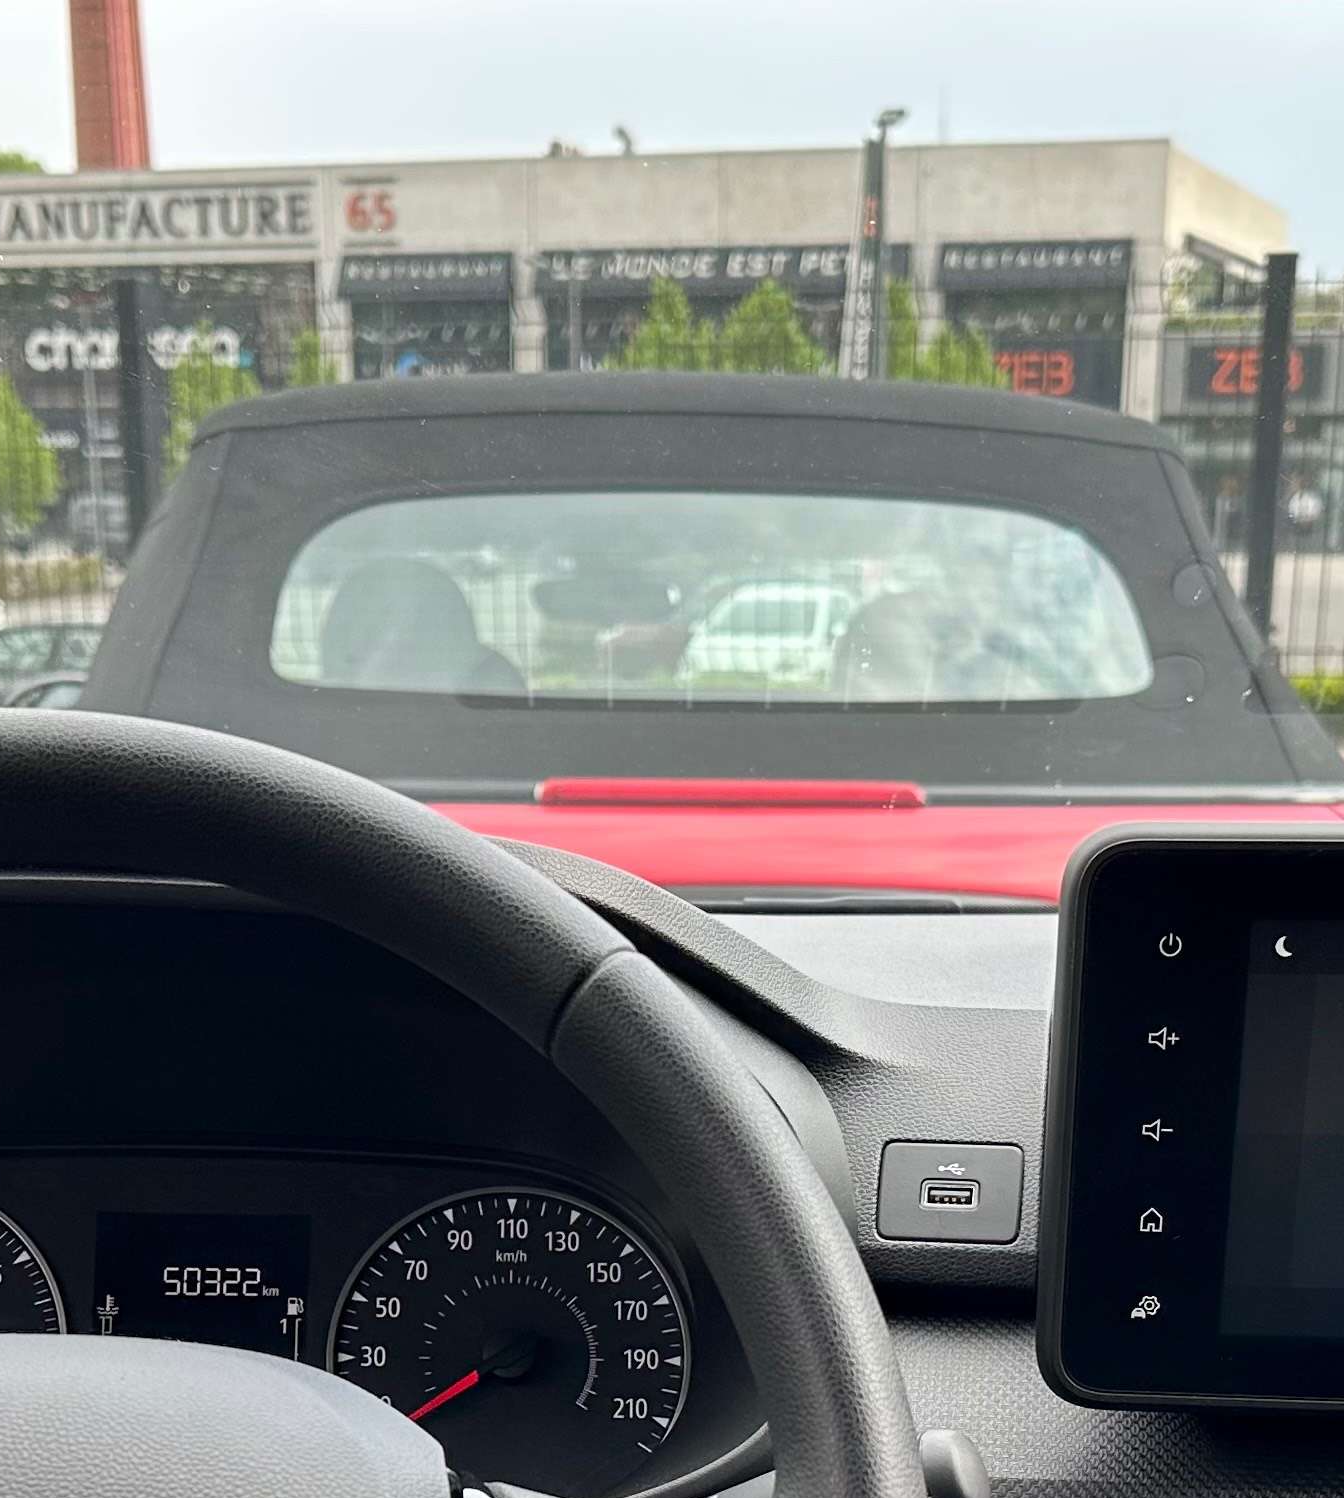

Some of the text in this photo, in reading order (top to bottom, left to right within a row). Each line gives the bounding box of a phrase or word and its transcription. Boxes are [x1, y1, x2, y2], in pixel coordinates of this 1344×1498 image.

[344, 190, 398, 232] 65
[447, 1229, 473, 1251] 90
[497, 1219, 529, 1239] 110
[544, 1231, 580, 1252] 130
[495, 1249, 527, 1264] km/h
[404, 1259, 428, 1281] 70
[586, 1262, 623, 1283] 150
[163, 1266, 280, 1297] 50322 km
[375, 1296, 401, 1318] 50
[613, 1300, 648, 1321] 170
[360, 1346, 386, 1367] 30
[623, 1348, 659, 1370] 190
[612, 1397, 648, 1419] 210
